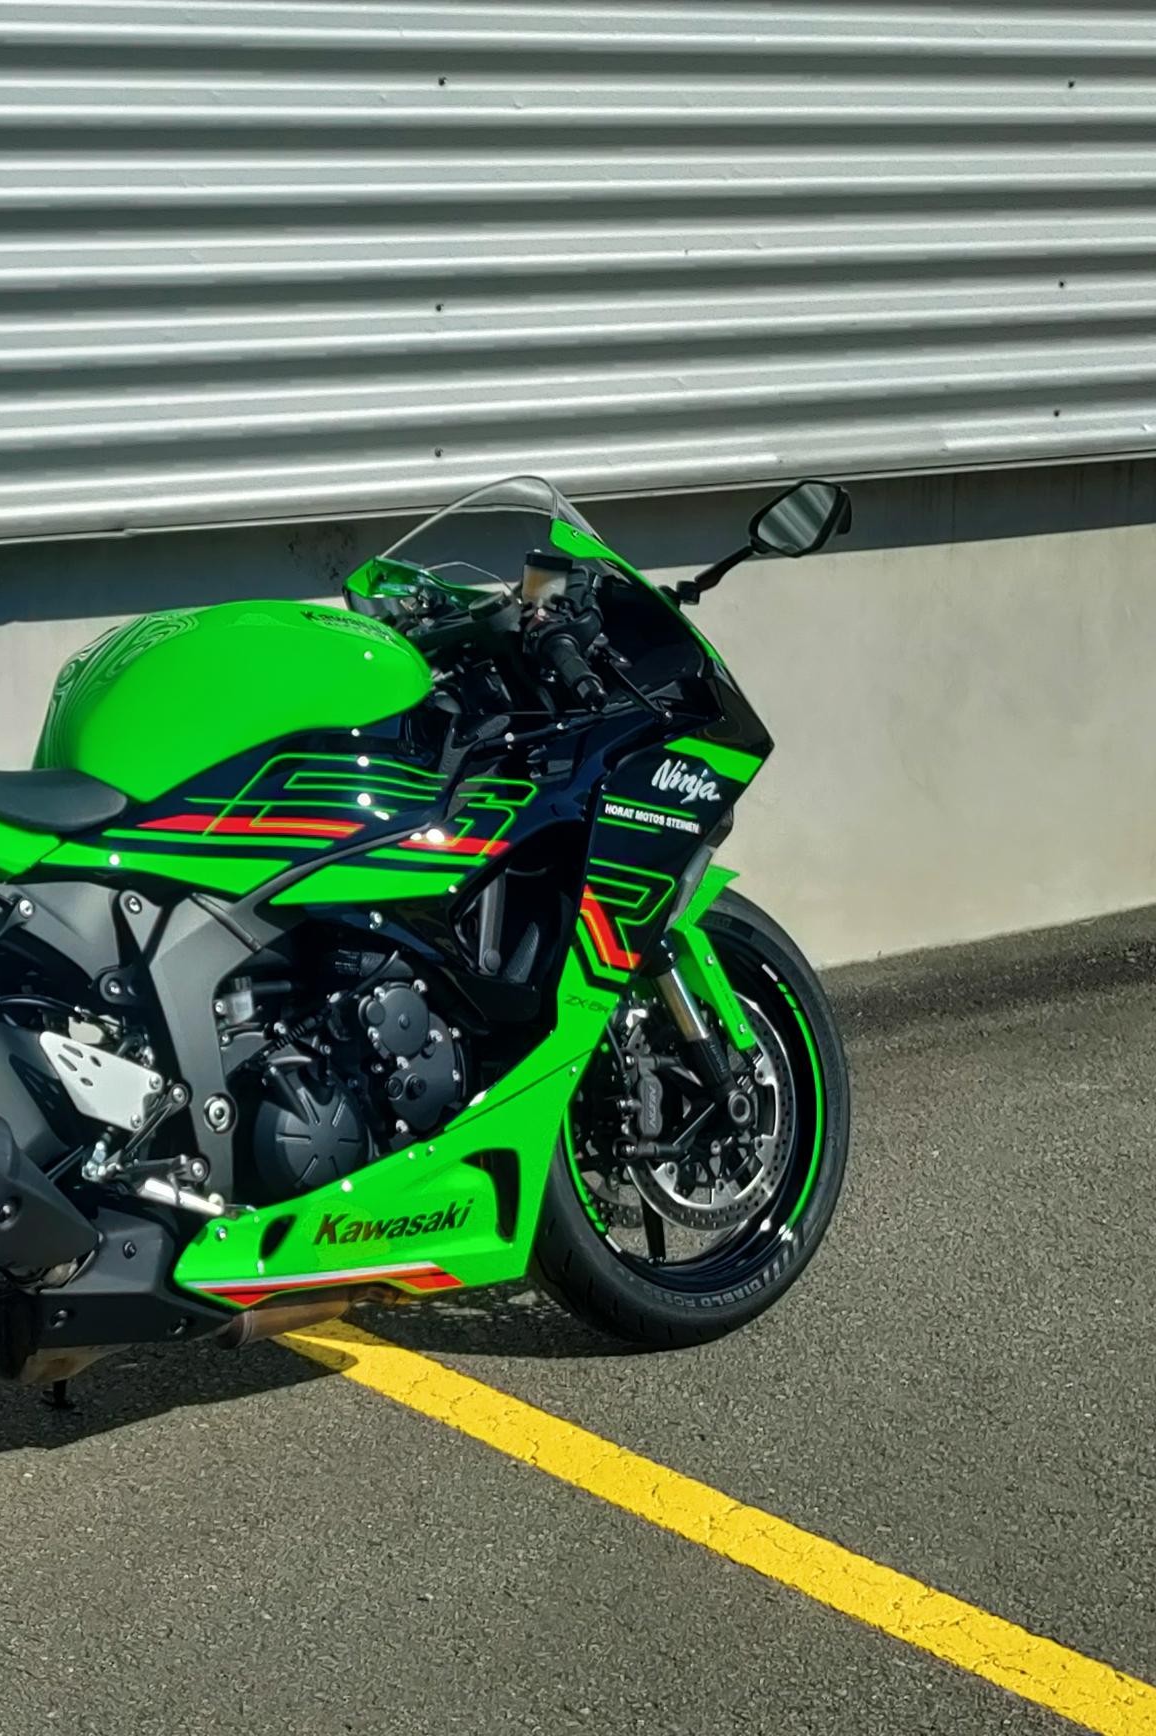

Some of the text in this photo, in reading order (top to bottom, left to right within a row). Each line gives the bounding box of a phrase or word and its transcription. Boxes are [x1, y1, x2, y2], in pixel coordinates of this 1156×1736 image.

[651, 758, 722, 804] Ninja
[604, 803, 635, 819] HORAT
[635, 810, 665, 827] MOTOS
[312, 1197, 475, 1246] Kawasaki
[700, 1277, 763, 1308] DIABLO
